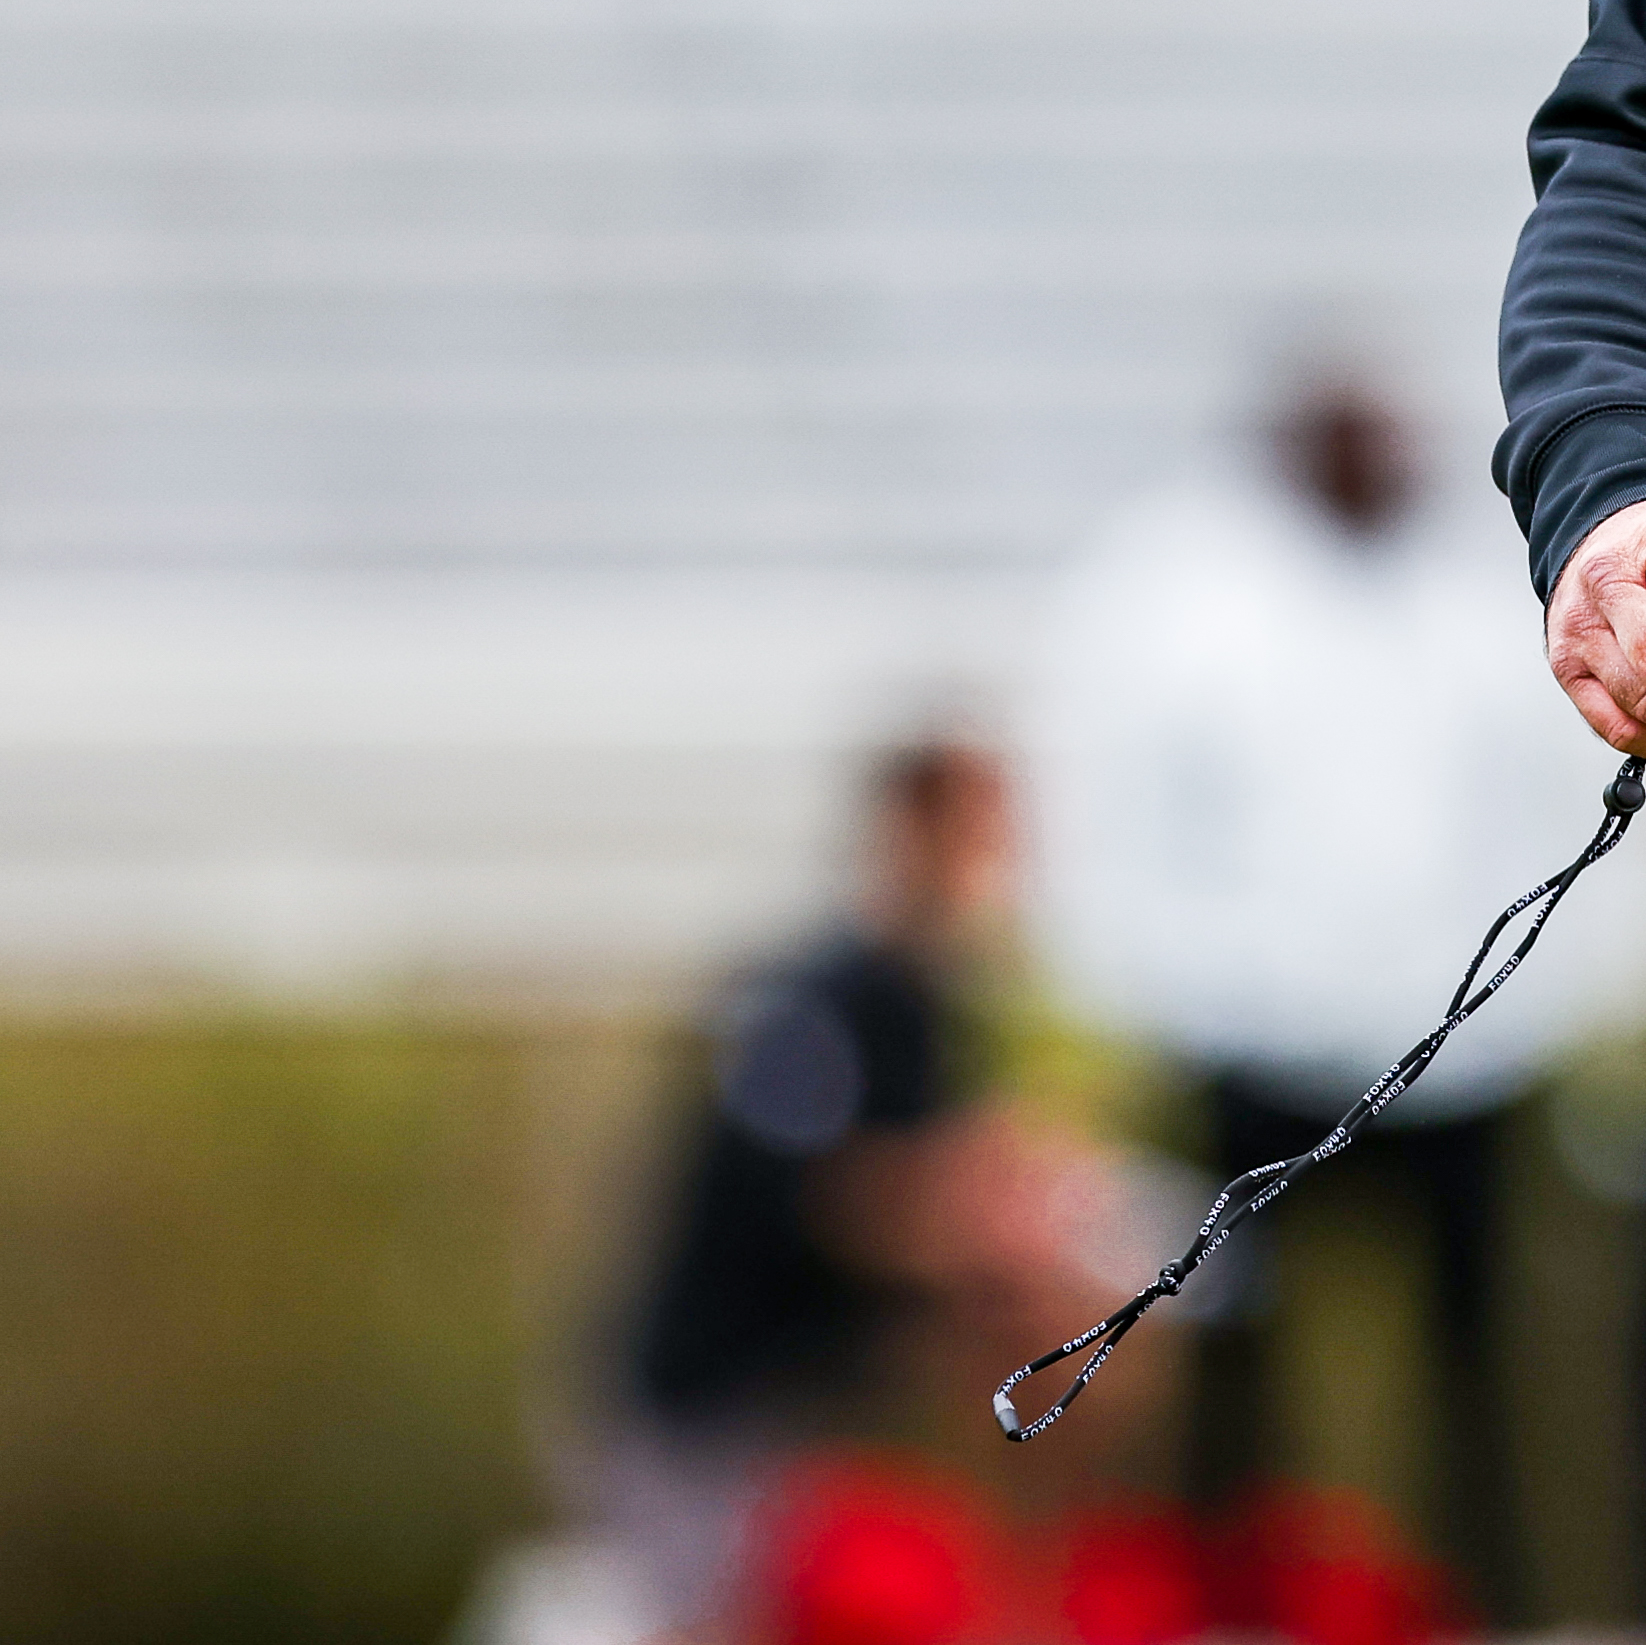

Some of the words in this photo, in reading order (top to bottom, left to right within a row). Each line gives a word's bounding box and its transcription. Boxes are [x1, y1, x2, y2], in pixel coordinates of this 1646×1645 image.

[1363, 1063, 1400, 1103] FOX40
[1371, 1080, 1406, 1115] FOX40
[1312, 1126, 1347, 1162] FOX40
[1200, 1192, 1230, 1236] FOX40
[1062, 1320, 1107, 1353] FOX40
[1021, 1406, 1063, 1441] FOX40
